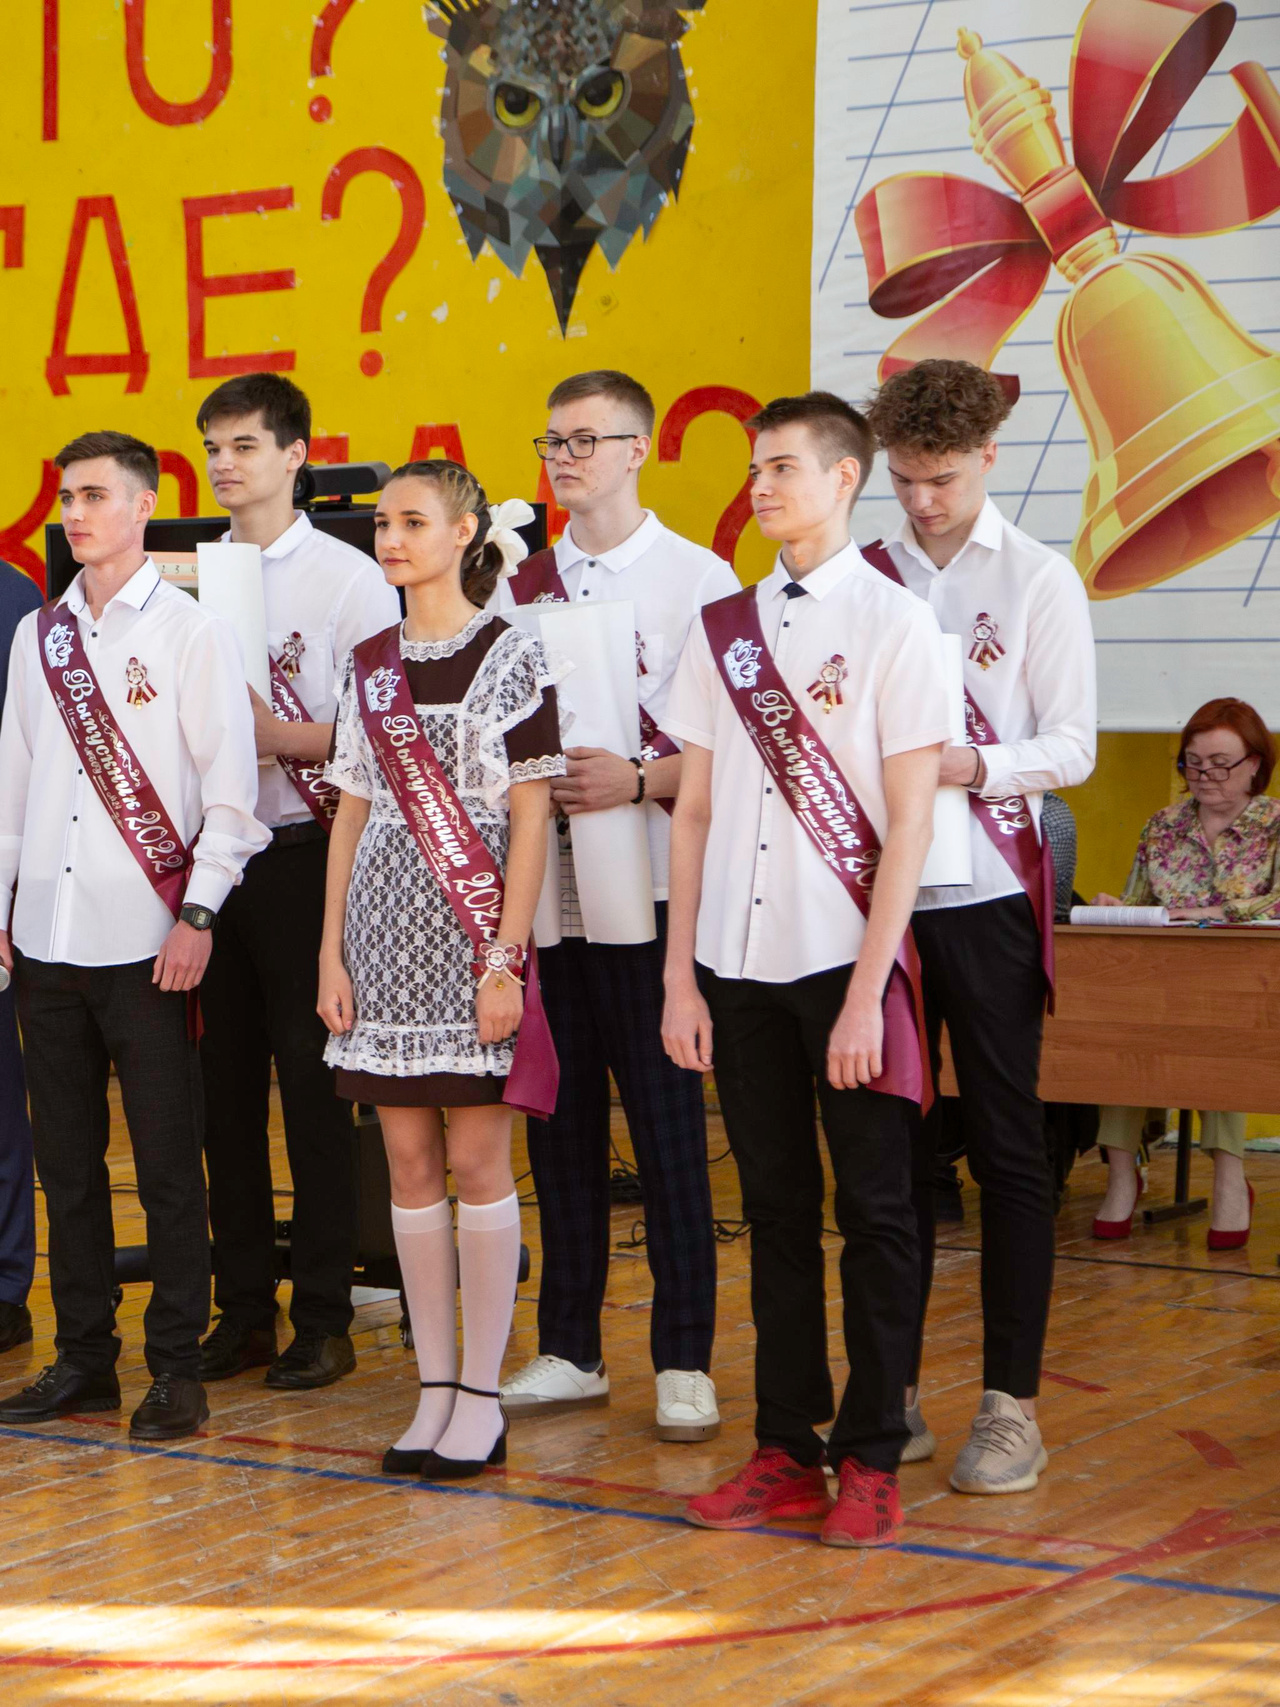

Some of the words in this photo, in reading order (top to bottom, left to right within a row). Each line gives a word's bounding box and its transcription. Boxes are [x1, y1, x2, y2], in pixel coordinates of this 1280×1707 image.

[62, 668, 141, 811] Выпускник
[124, 810, 184, 874] 2022
[381, 714, 470, 868] Выпускница
[751, 689, 861, 850] Выпускник
